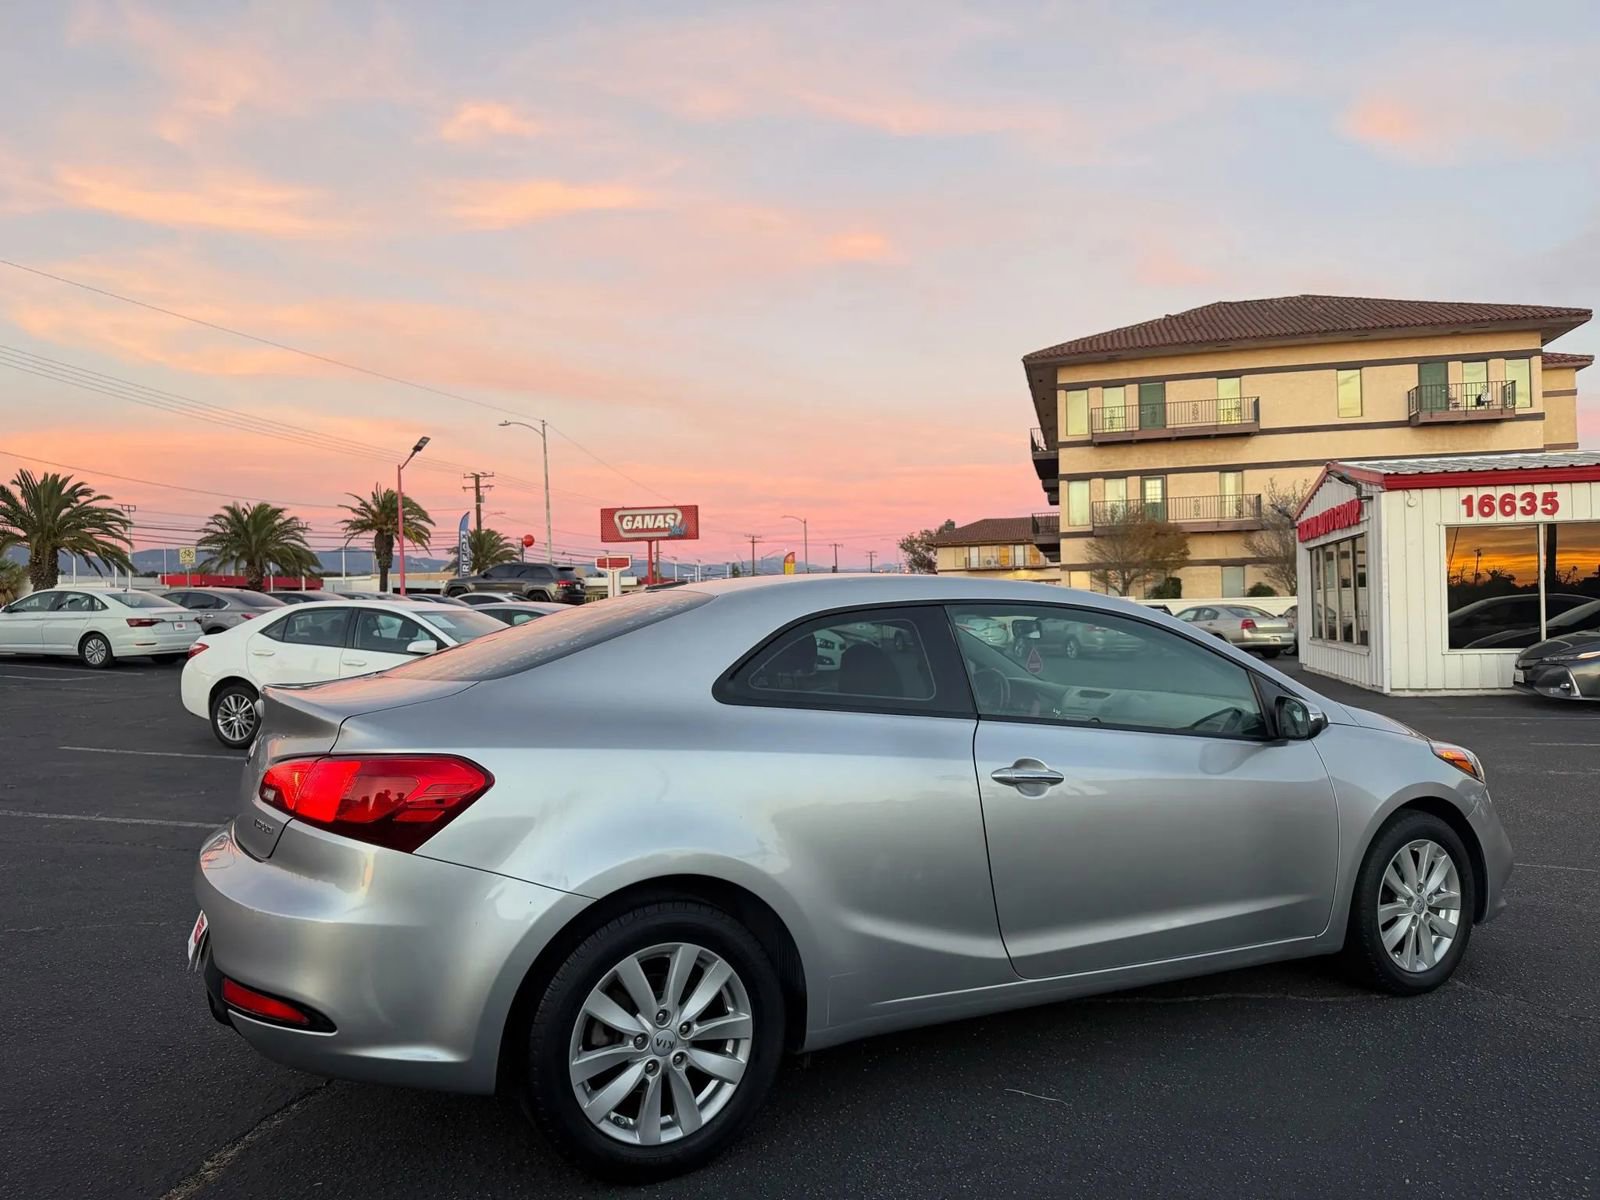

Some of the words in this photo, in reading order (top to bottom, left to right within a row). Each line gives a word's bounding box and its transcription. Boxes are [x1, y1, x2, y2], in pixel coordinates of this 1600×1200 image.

[1334, 499, 1361, 530] GROUP
[1461, 491, 1560, 518] 16635
[622, 513, 675, 530] GANAS
[656, 1037, 675, 1049] KIA
